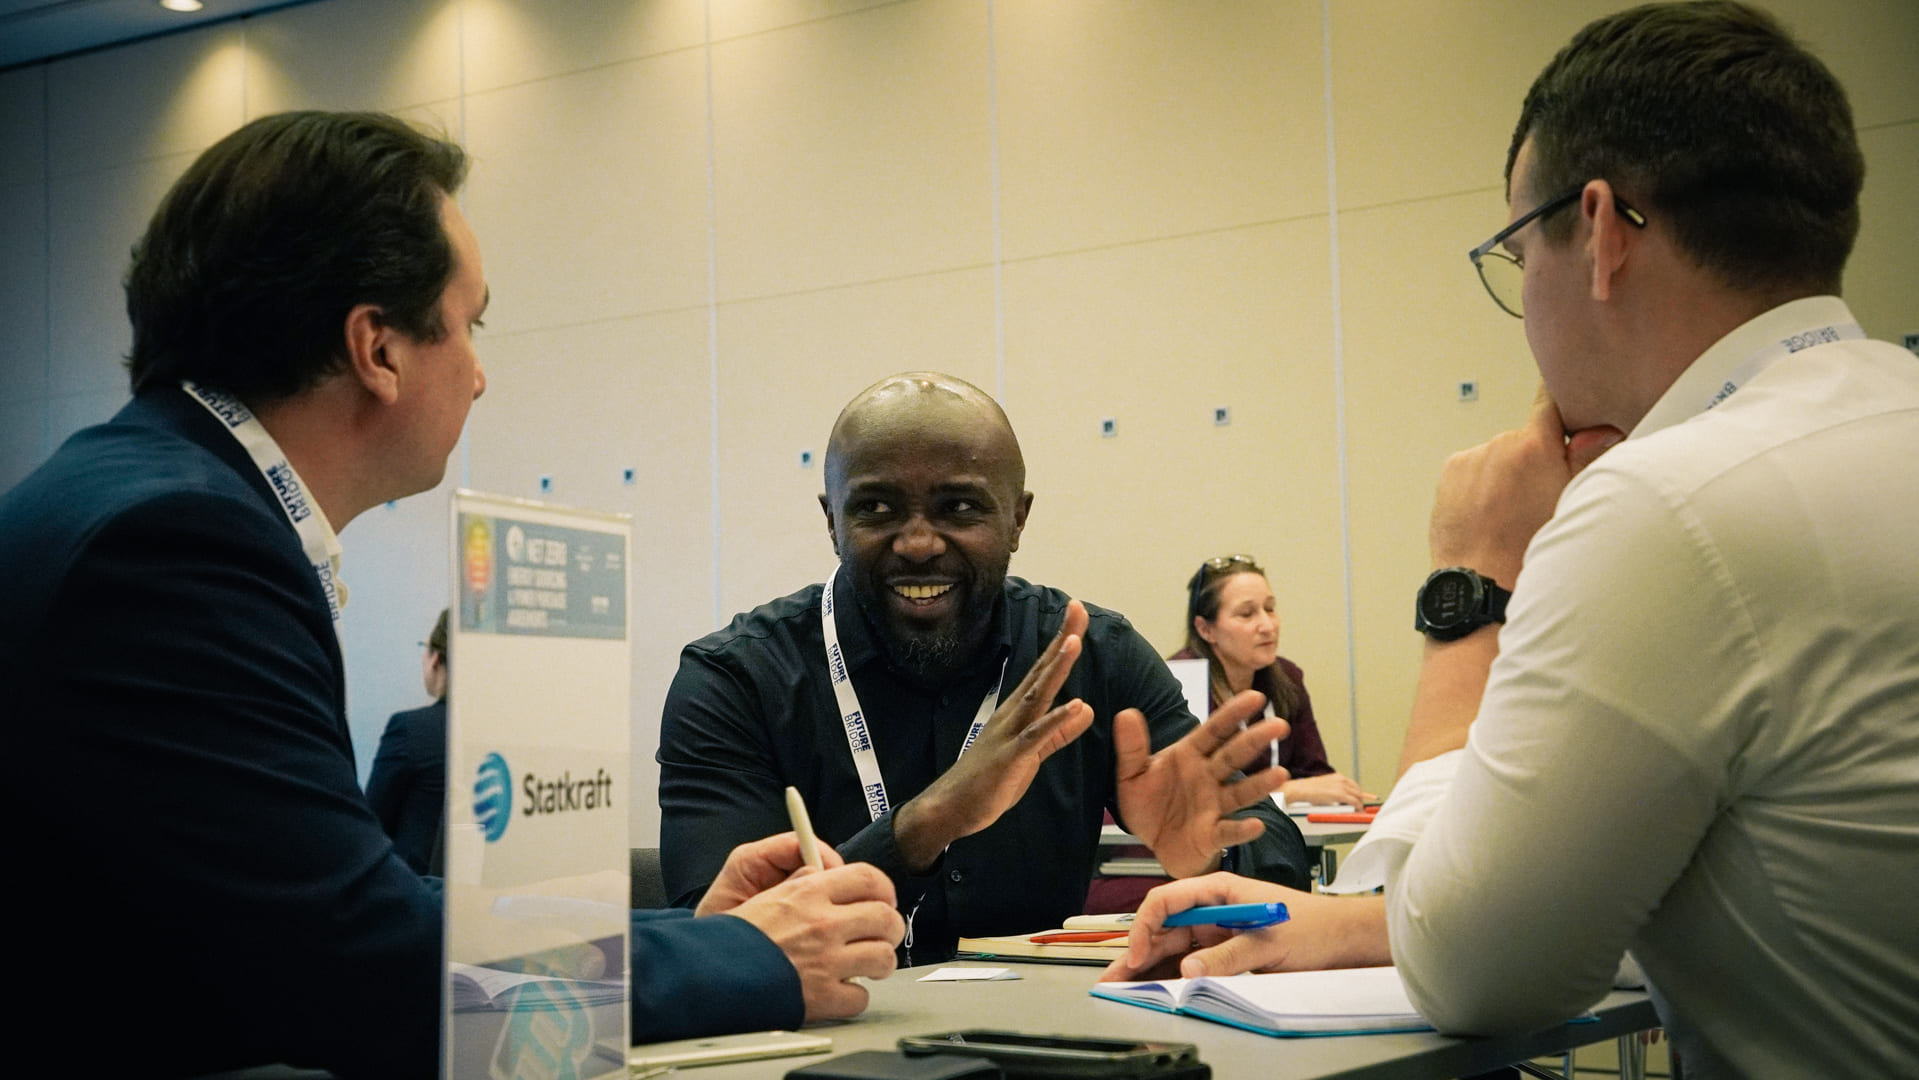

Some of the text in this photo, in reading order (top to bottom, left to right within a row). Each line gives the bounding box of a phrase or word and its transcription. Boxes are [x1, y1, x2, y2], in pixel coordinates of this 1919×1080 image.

[266, 466, 303, 523] FUTURE
[827, 646, 841, 686] BRIDGE
[832, 642, 848, 682] FUTURE
[844, 714, 863, 754] BRIDGE
[852, 710, 871, 752] FUTURE
[523, 768, 612, 817] Statkraft
